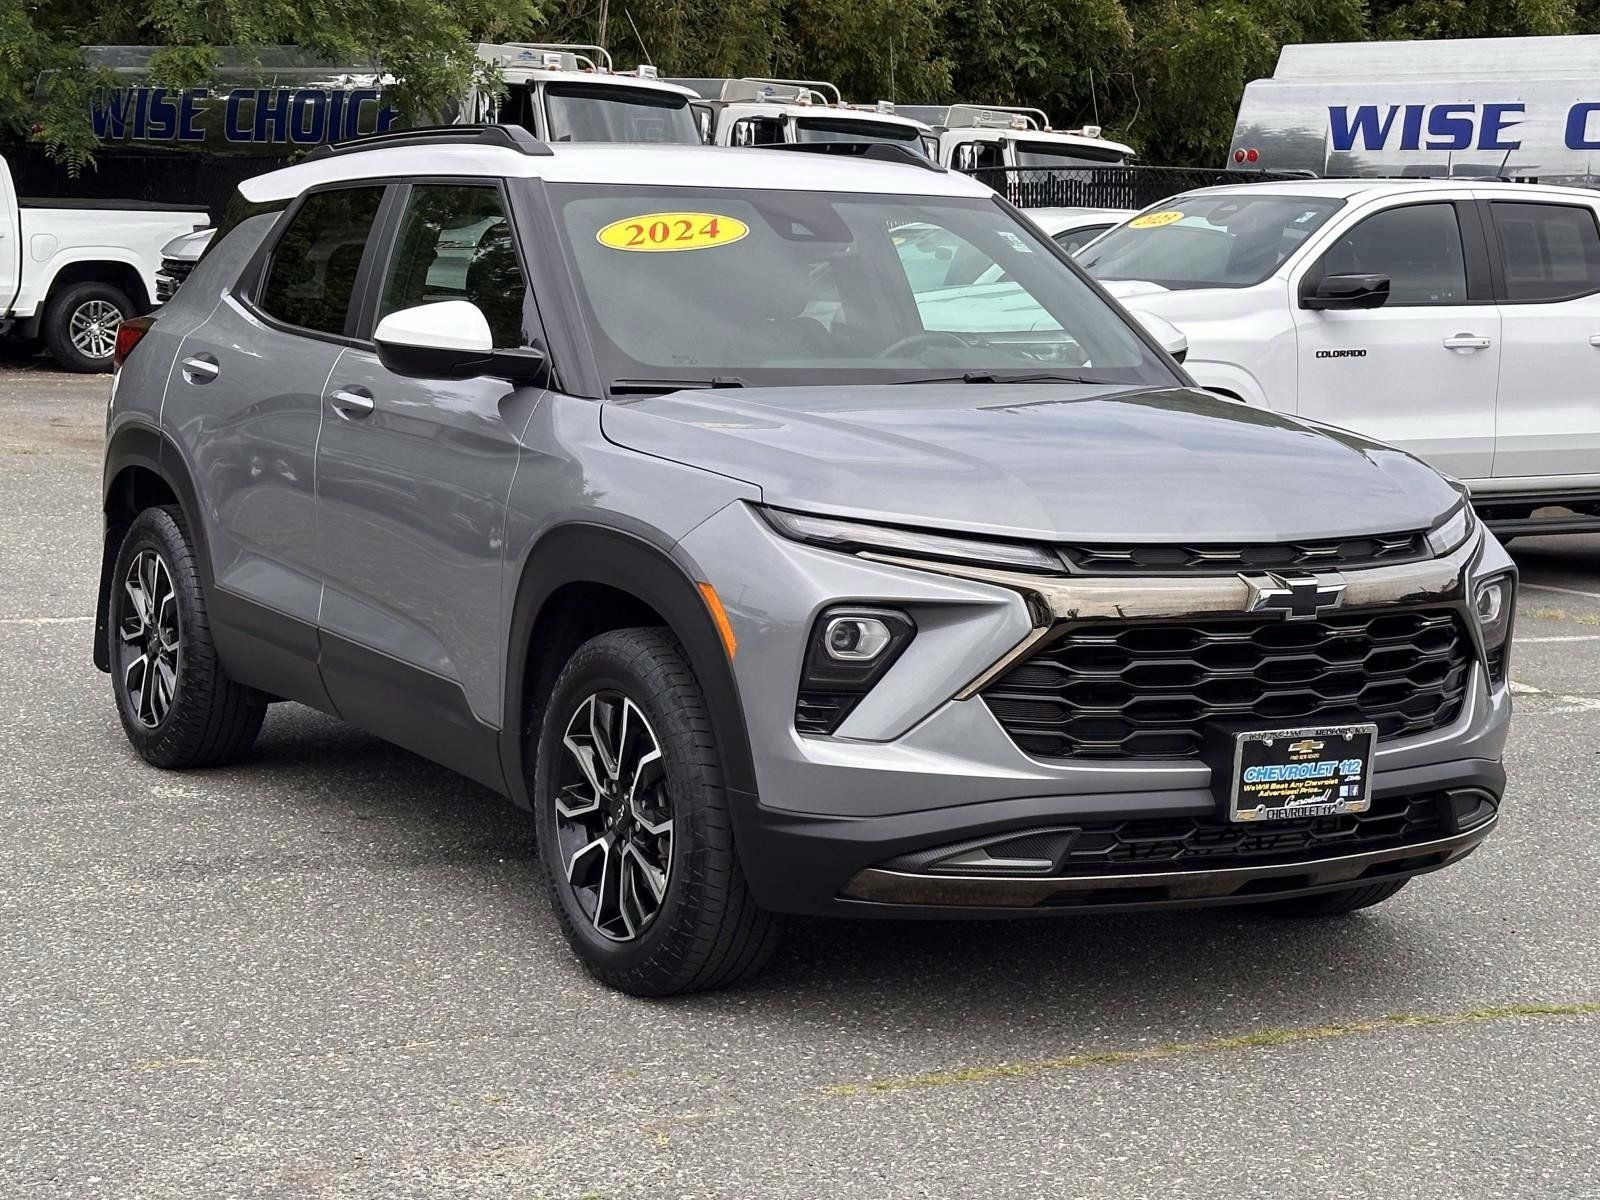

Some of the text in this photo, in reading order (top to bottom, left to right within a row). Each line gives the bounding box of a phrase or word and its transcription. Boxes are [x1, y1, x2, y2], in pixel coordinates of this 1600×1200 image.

[91, 87, 210, 142] WISE
[1328, 103, 1525, 151] WISE
[625, 218, 720, 246] 2024
[1315, 349, 1367, 358] COLORADO
[1244, 759, 1362, 783] CHEVROLET 112
[1258, 788, 1299, 797] Advertised
[1304, 779, 1339, 787] Chevrolet
[1266, 804, 1337, 819] CHEVROLET 112
